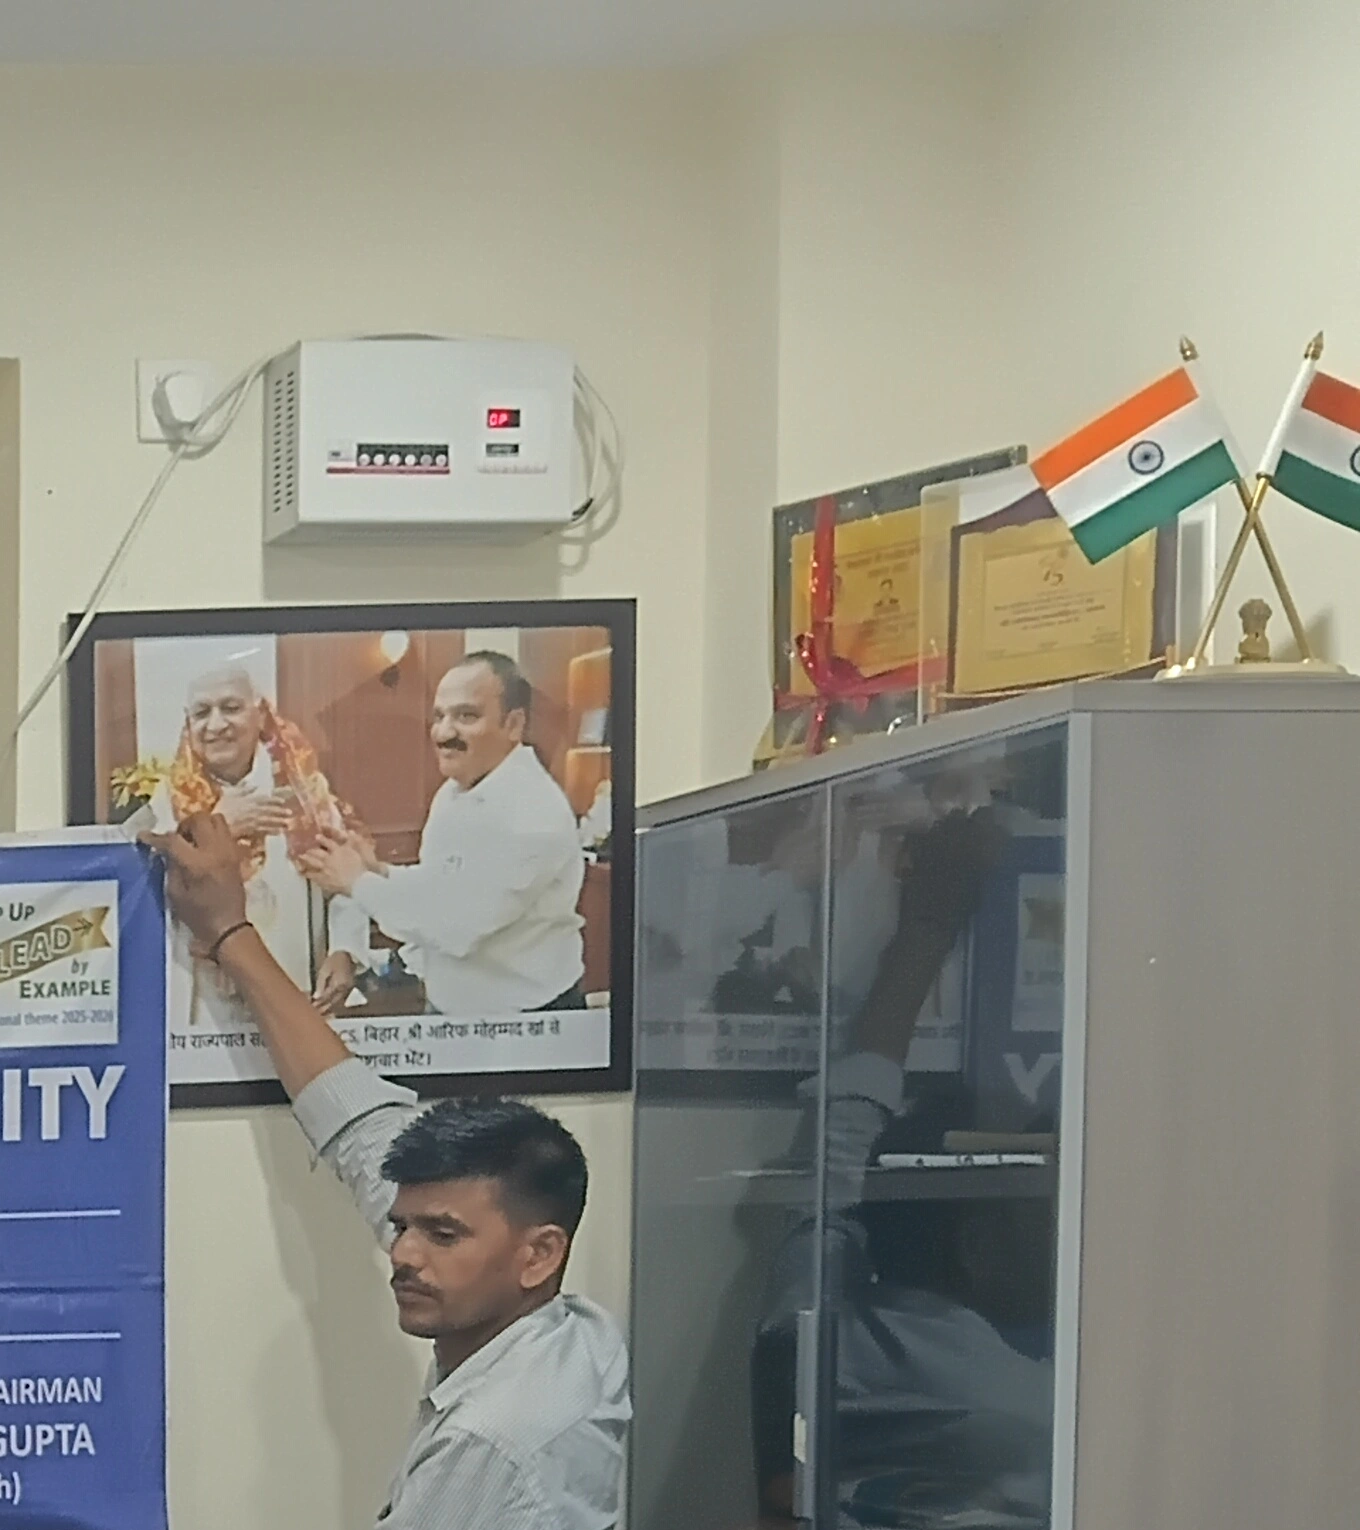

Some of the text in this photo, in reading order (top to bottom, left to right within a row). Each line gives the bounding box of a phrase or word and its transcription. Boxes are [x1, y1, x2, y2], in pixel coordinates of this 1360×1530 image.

[71, 959, 89, 976] by
[19, 979, 111, 999] EXAMPLE
[24, 1011, 58, 1026] theme
